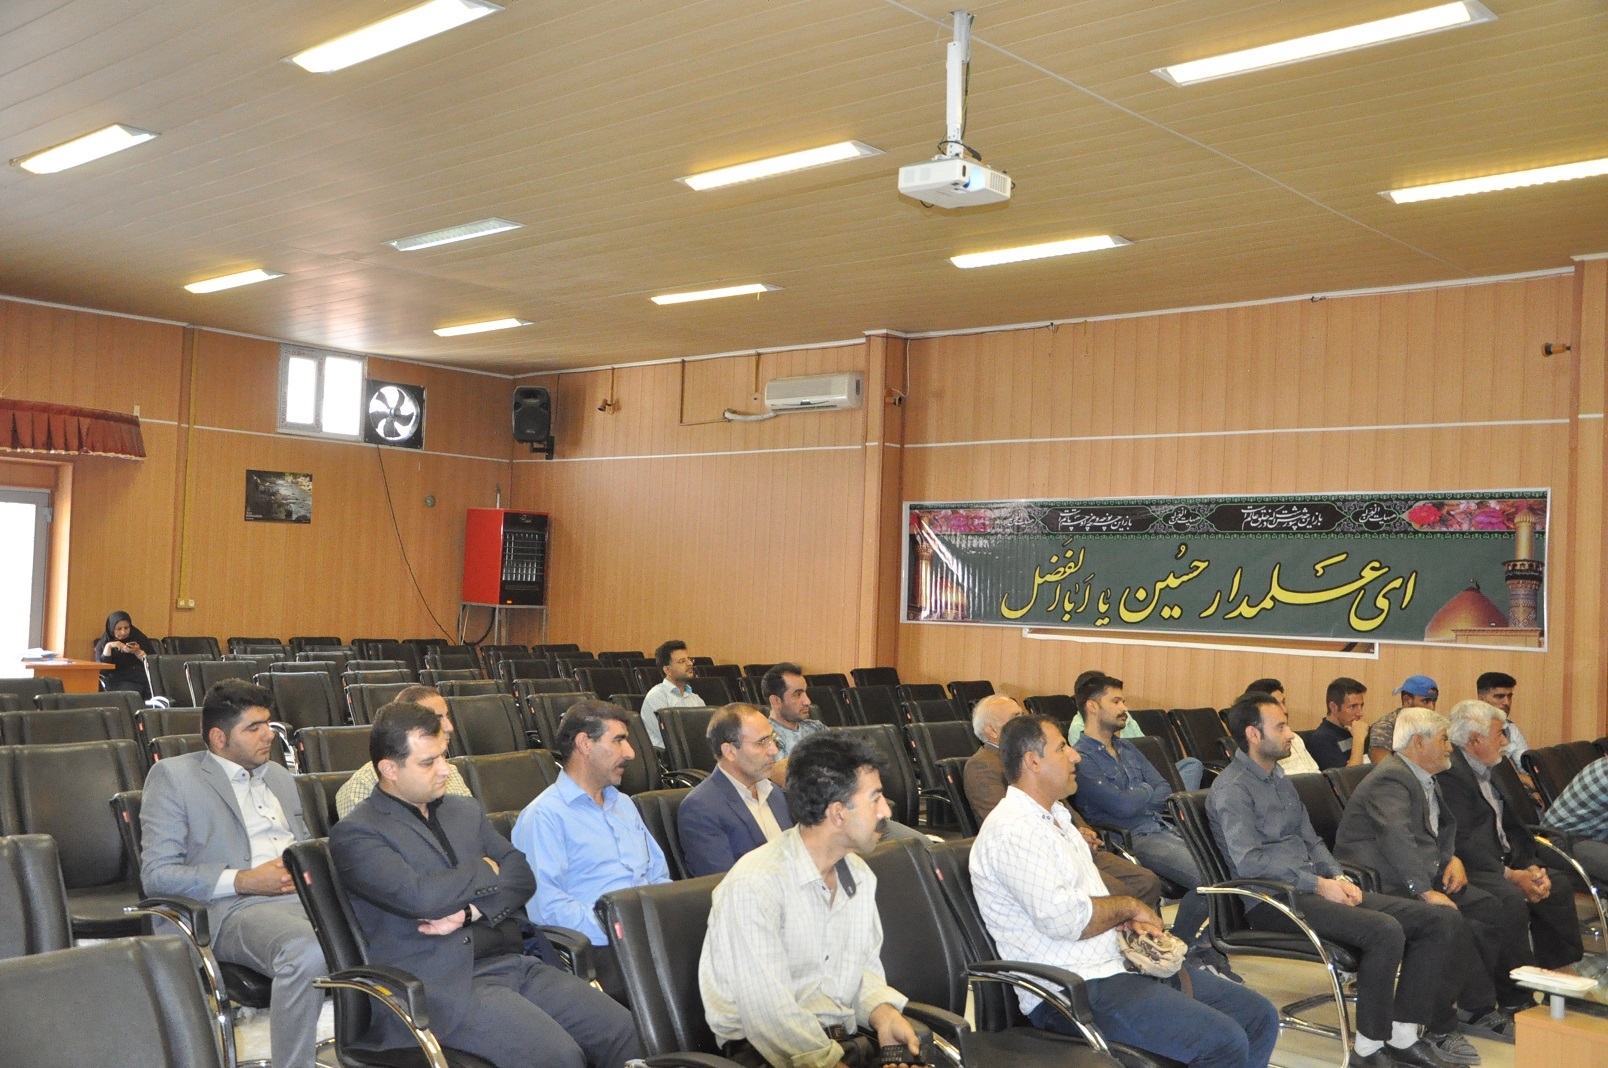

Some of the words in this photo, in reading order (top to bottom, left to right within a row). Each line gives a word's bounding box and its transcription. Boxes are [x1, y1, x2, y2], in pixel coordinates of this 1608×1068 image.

[1297, 516, 1315, 529] این
[1312, 512, 1323, 526] باز
[1349, 571, 1417, 632] ای
